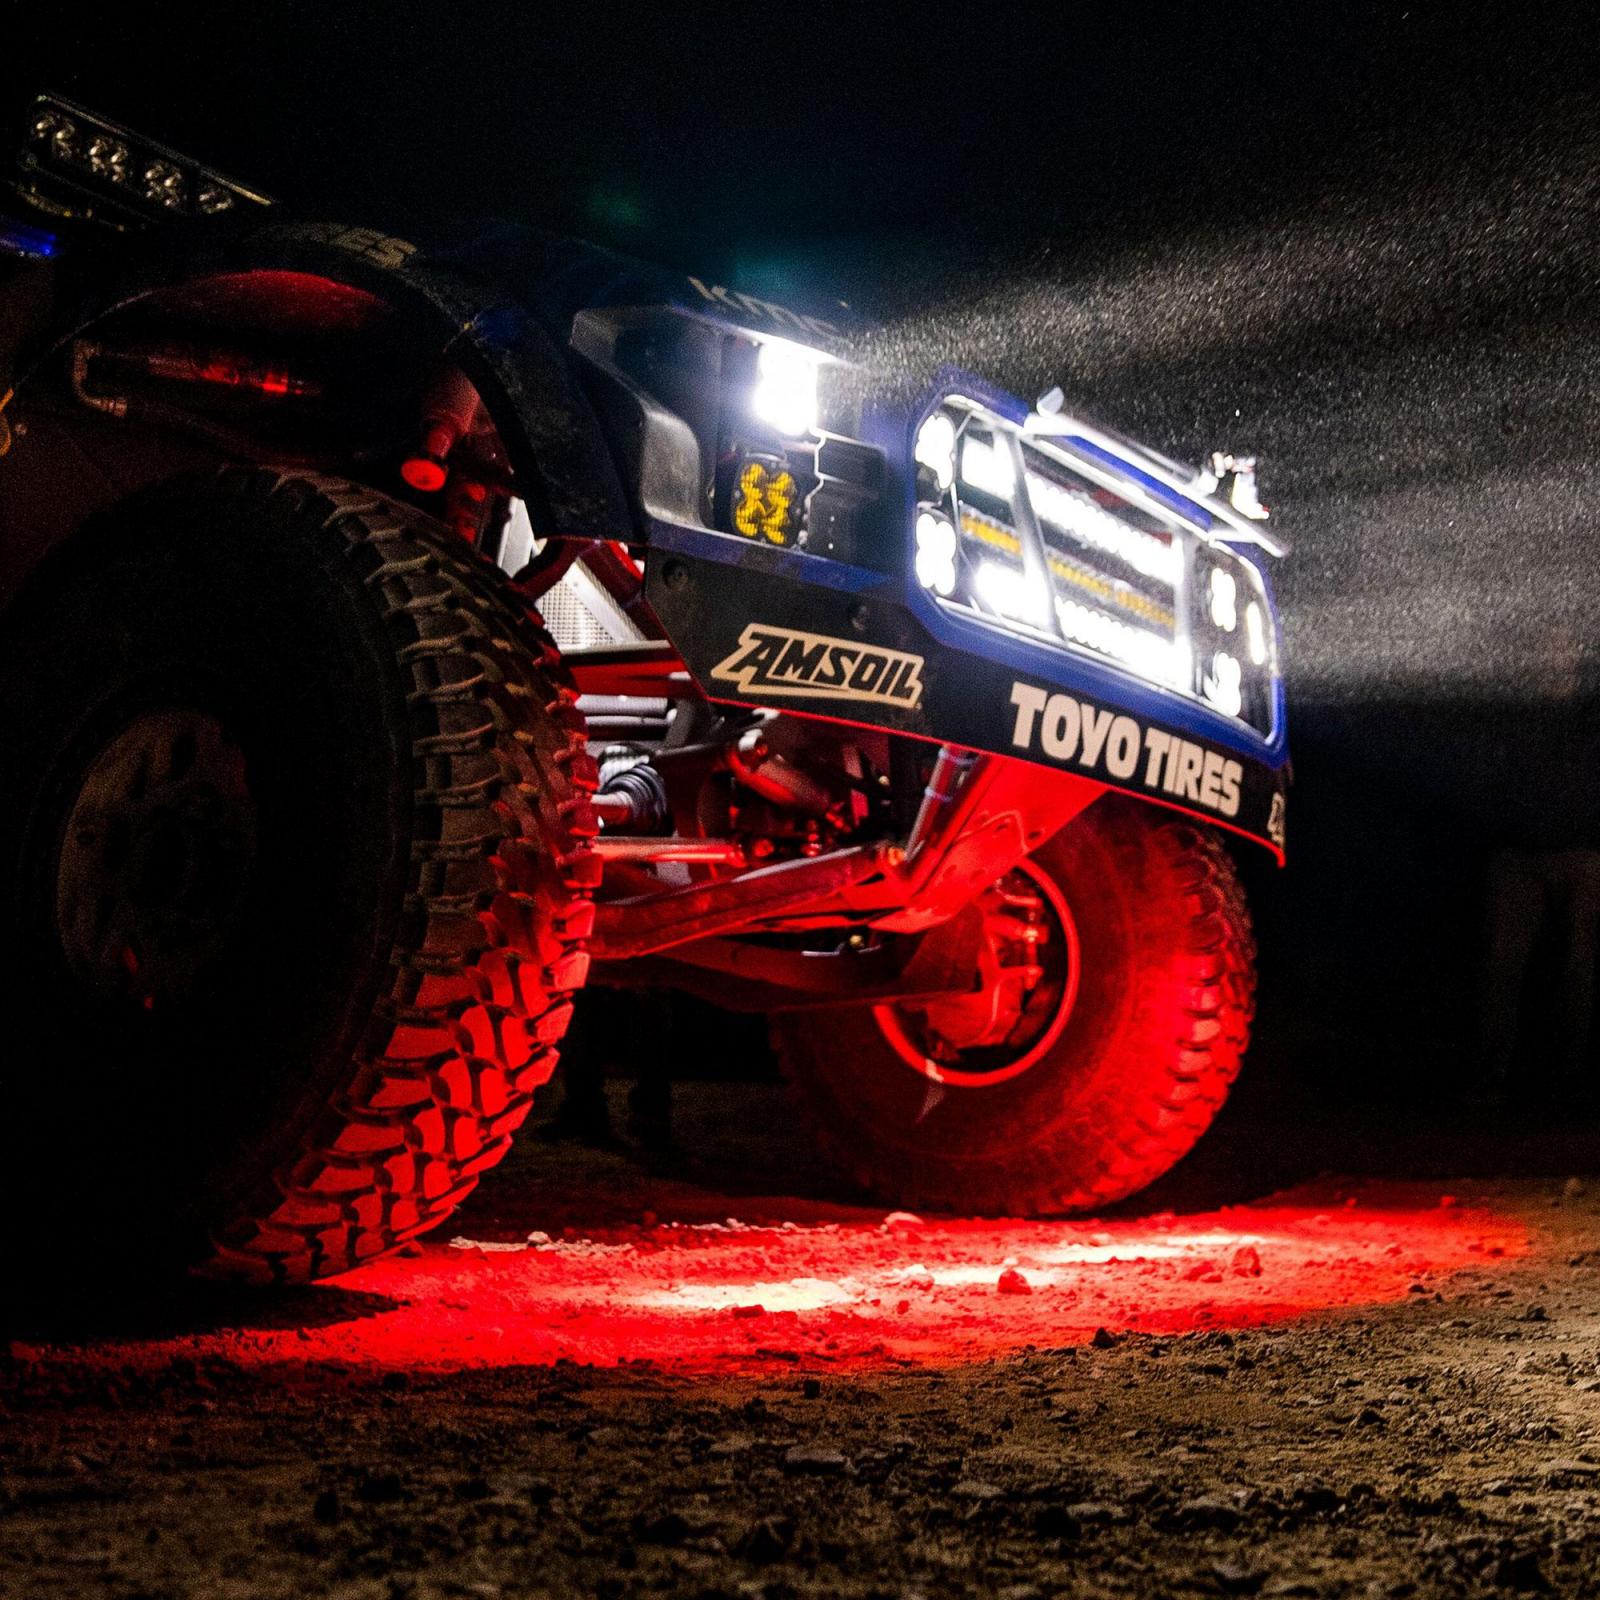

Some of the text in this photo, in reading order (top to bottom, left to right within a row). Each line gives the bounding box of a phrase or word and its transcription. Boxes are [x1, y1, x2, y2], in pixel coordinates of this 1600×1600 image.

[719, 628, 920, 704] AMSOIL
[1010, 681, 1243, 817] TOYO TIRES
